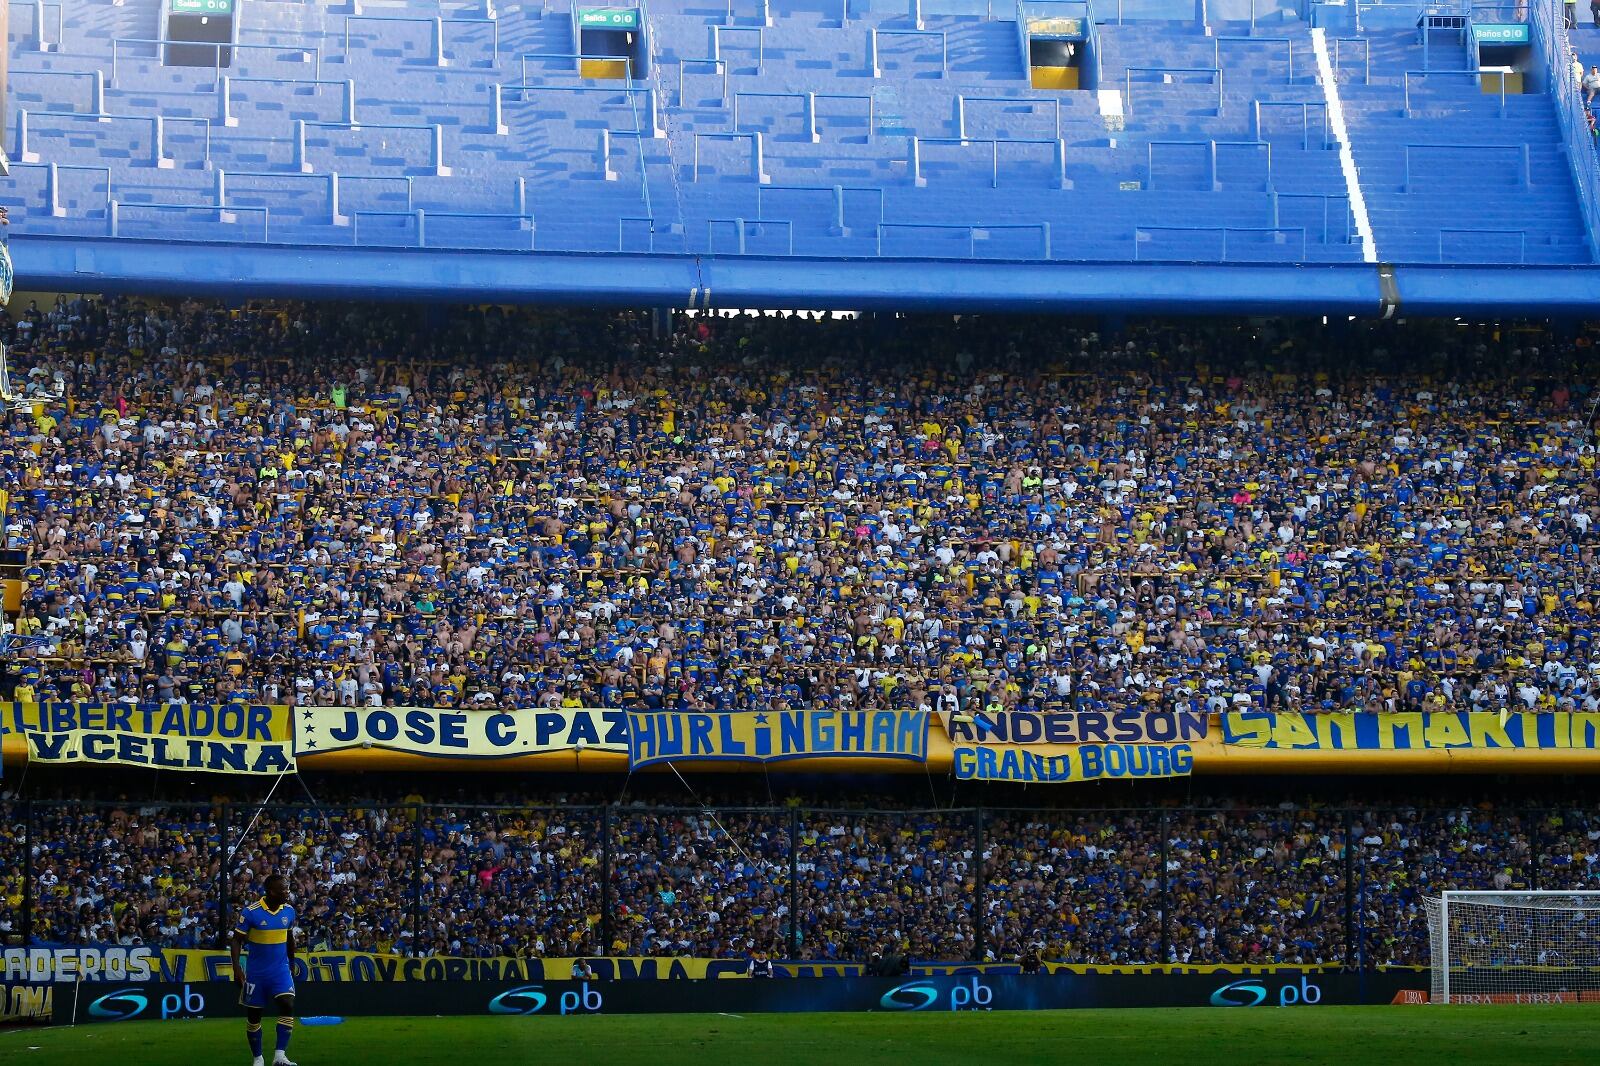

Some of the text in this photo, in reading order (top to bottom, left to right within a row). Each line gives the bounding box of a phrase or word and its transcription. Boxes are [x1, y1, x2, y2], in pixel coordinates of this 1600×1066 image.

[1476, 29, 1501, 38] Baños
[12, 703, 273, 741] LIBERTADOR
[949, 711, 1208, 743] ANDERSON
[1222, 712, 1358, 749] SAN
[954, 744, 1194, 782] GRAND BOURG
[0, 947, 152, 982] ADEROS
[162, 984, 204, 1020] pb
[246, 983, 256, 995] 17
[561, 981, 602, 1015] pb
[951, 976, 992, 1012] pb
[1280, 976, 1321, 1007] pb
